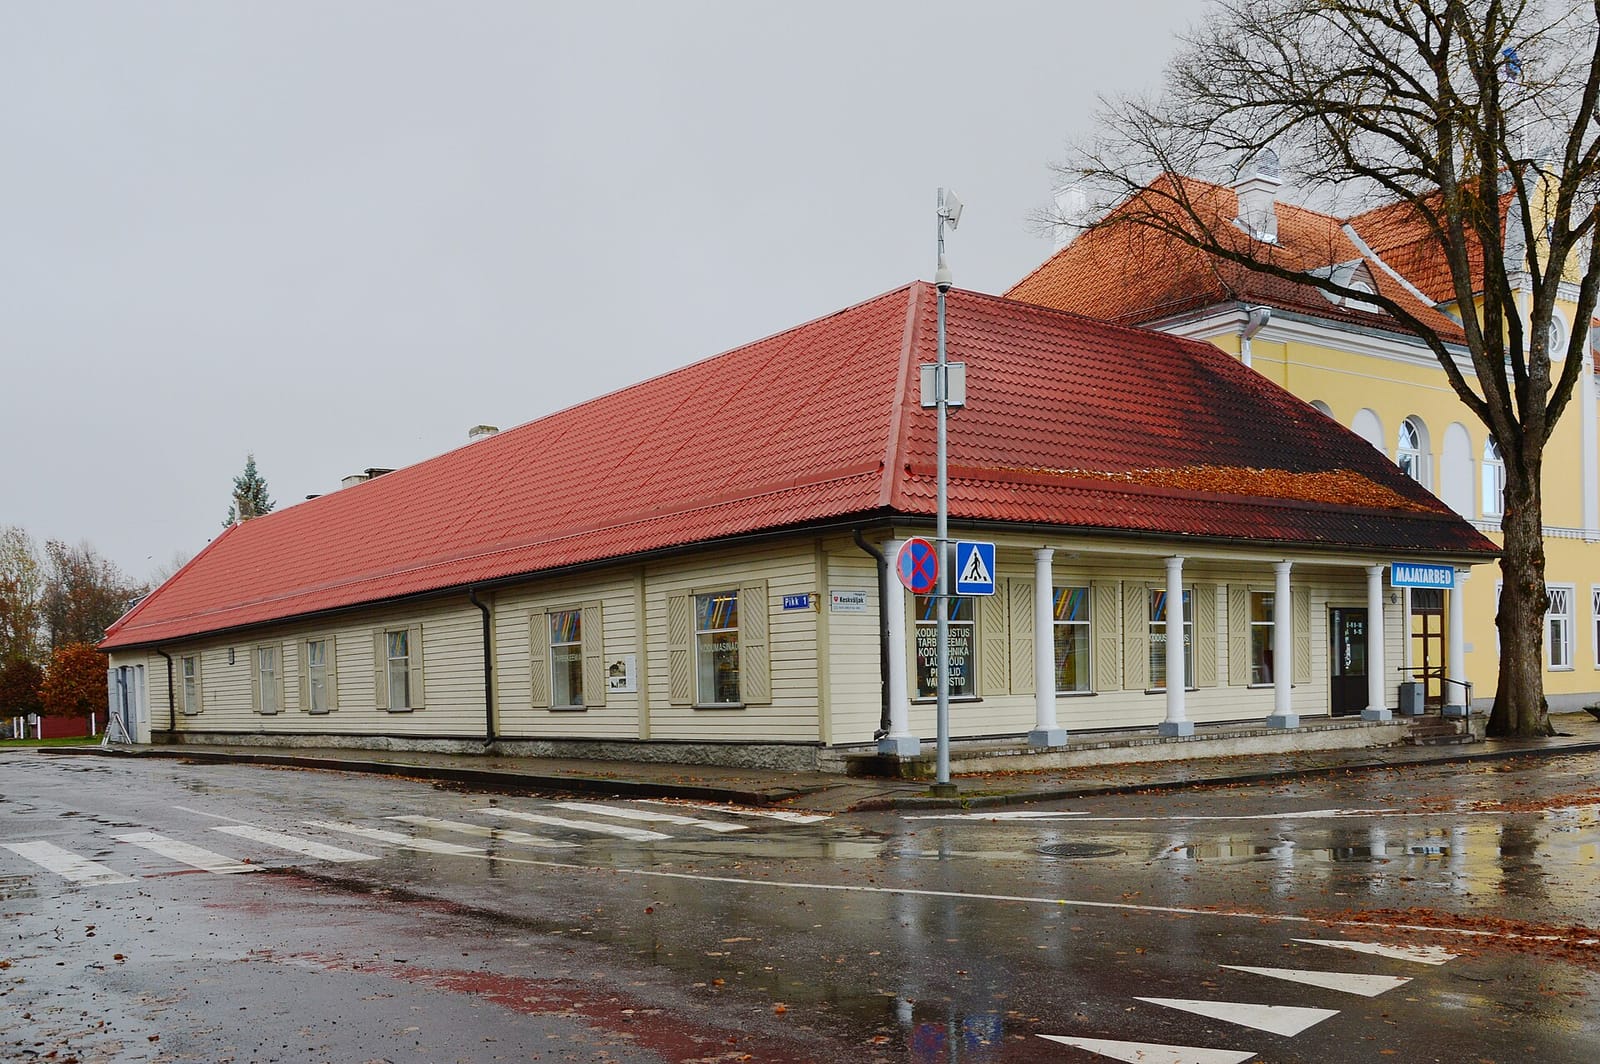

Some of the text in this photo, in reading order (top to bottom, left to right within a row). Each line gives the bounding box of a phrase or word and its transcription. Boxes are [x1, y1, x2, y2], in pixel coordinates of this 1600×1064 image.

[1395, 566, 1452, 585] MAJATARBED
[785, 596, 807, 607] Pikk 1
[839, 596, 864, 606] Keskväljak
[915, 628, 970, 638] KODUUSTUS
[917, 637, 968, 647] TARBEEMIA
[918, 647, 969, 657] KODUHNIKA
